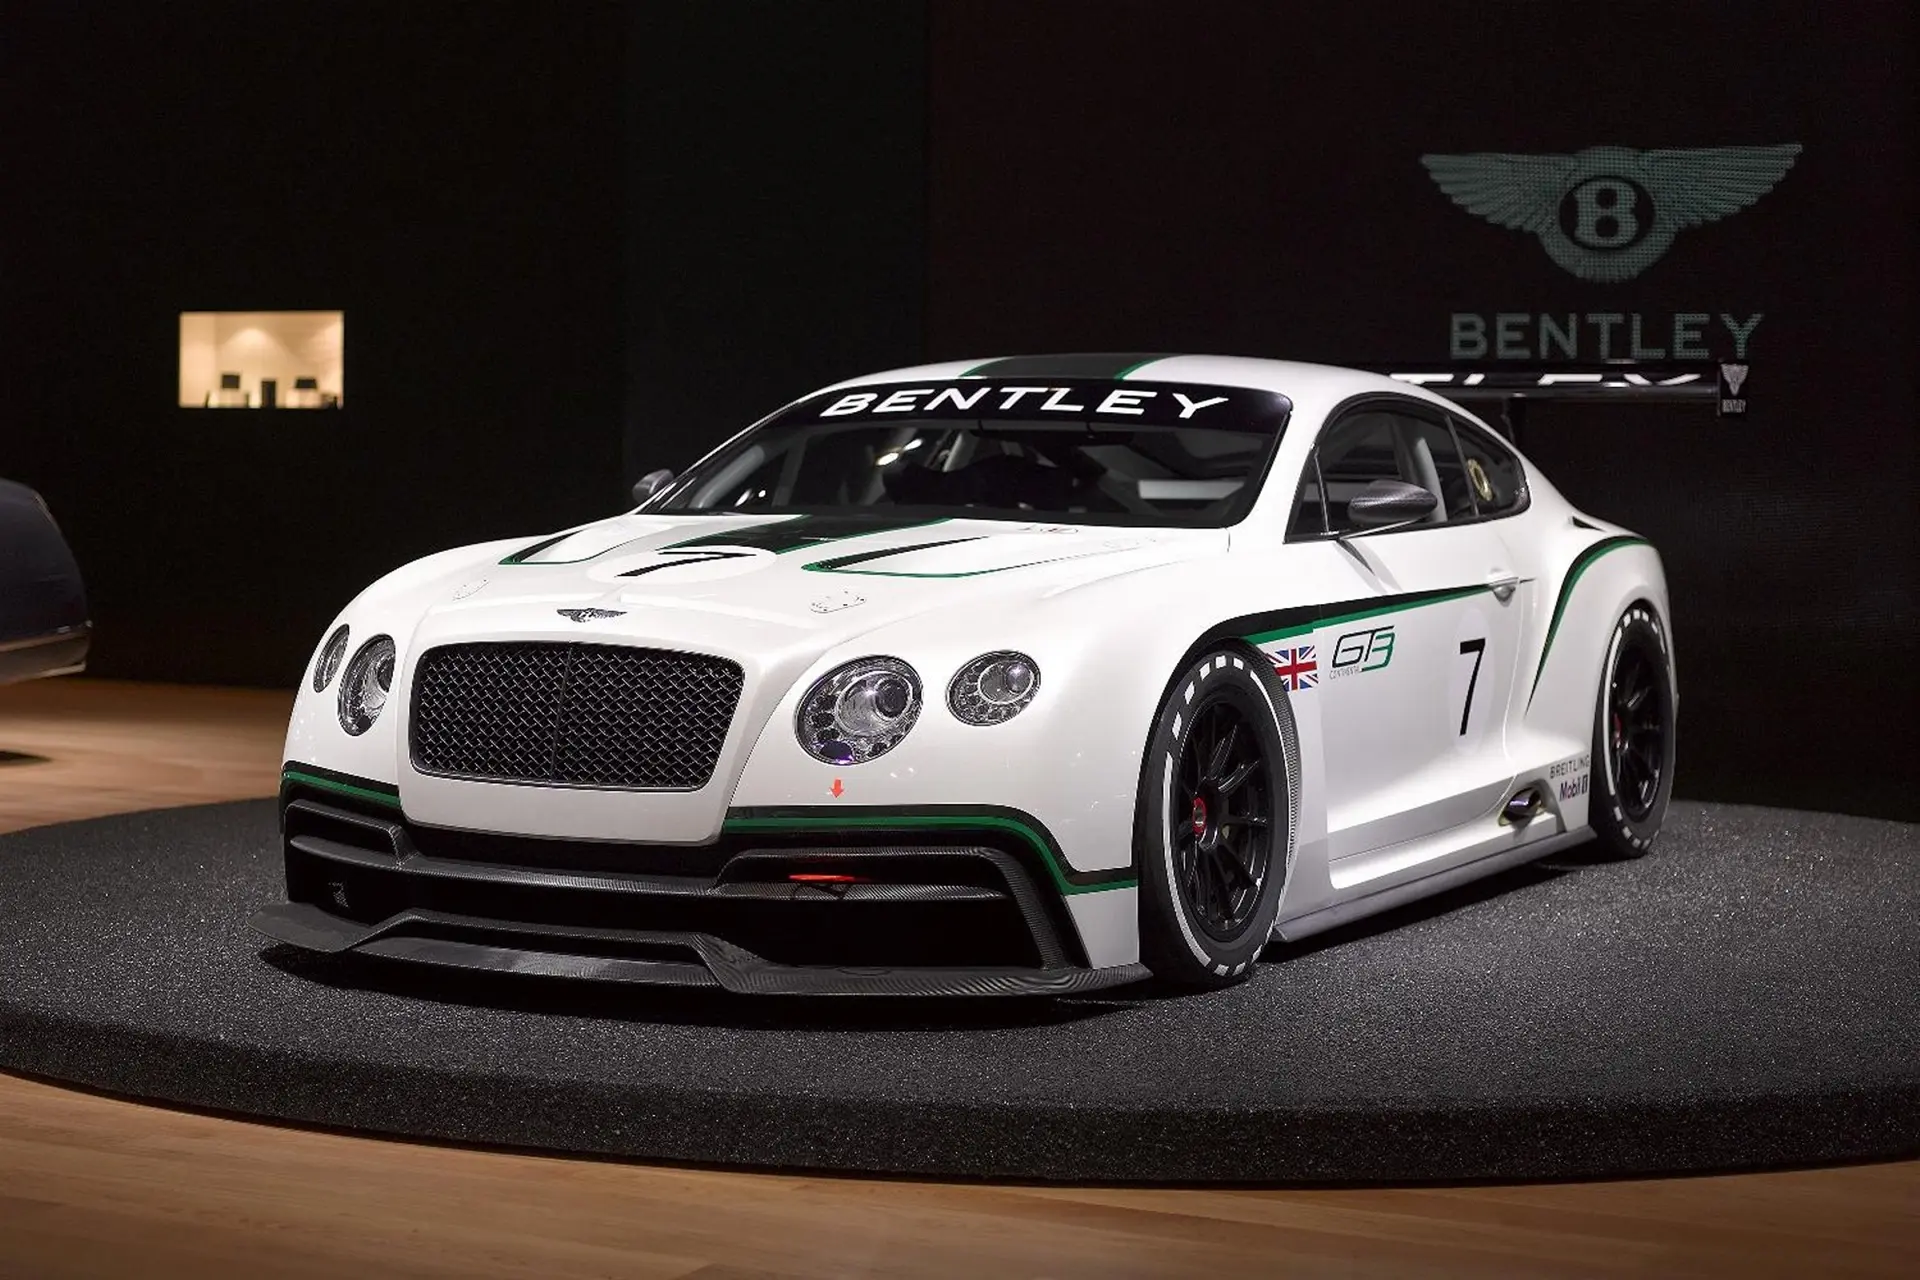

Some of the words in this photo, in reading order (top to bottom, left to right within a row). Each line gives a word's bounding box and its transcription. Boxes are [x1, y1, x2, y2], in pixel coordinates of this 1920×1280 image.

[1450, 312, 1764, 360] BENTLEY
[819, 387, 1229, 419] BENTLEY
[614, 550, 757, 578] 7
[1331, 625, 1396, 673] GT3
[1459, 637, 1486, 737] 7
[1550, 754, 1590, 780] BREITLING
